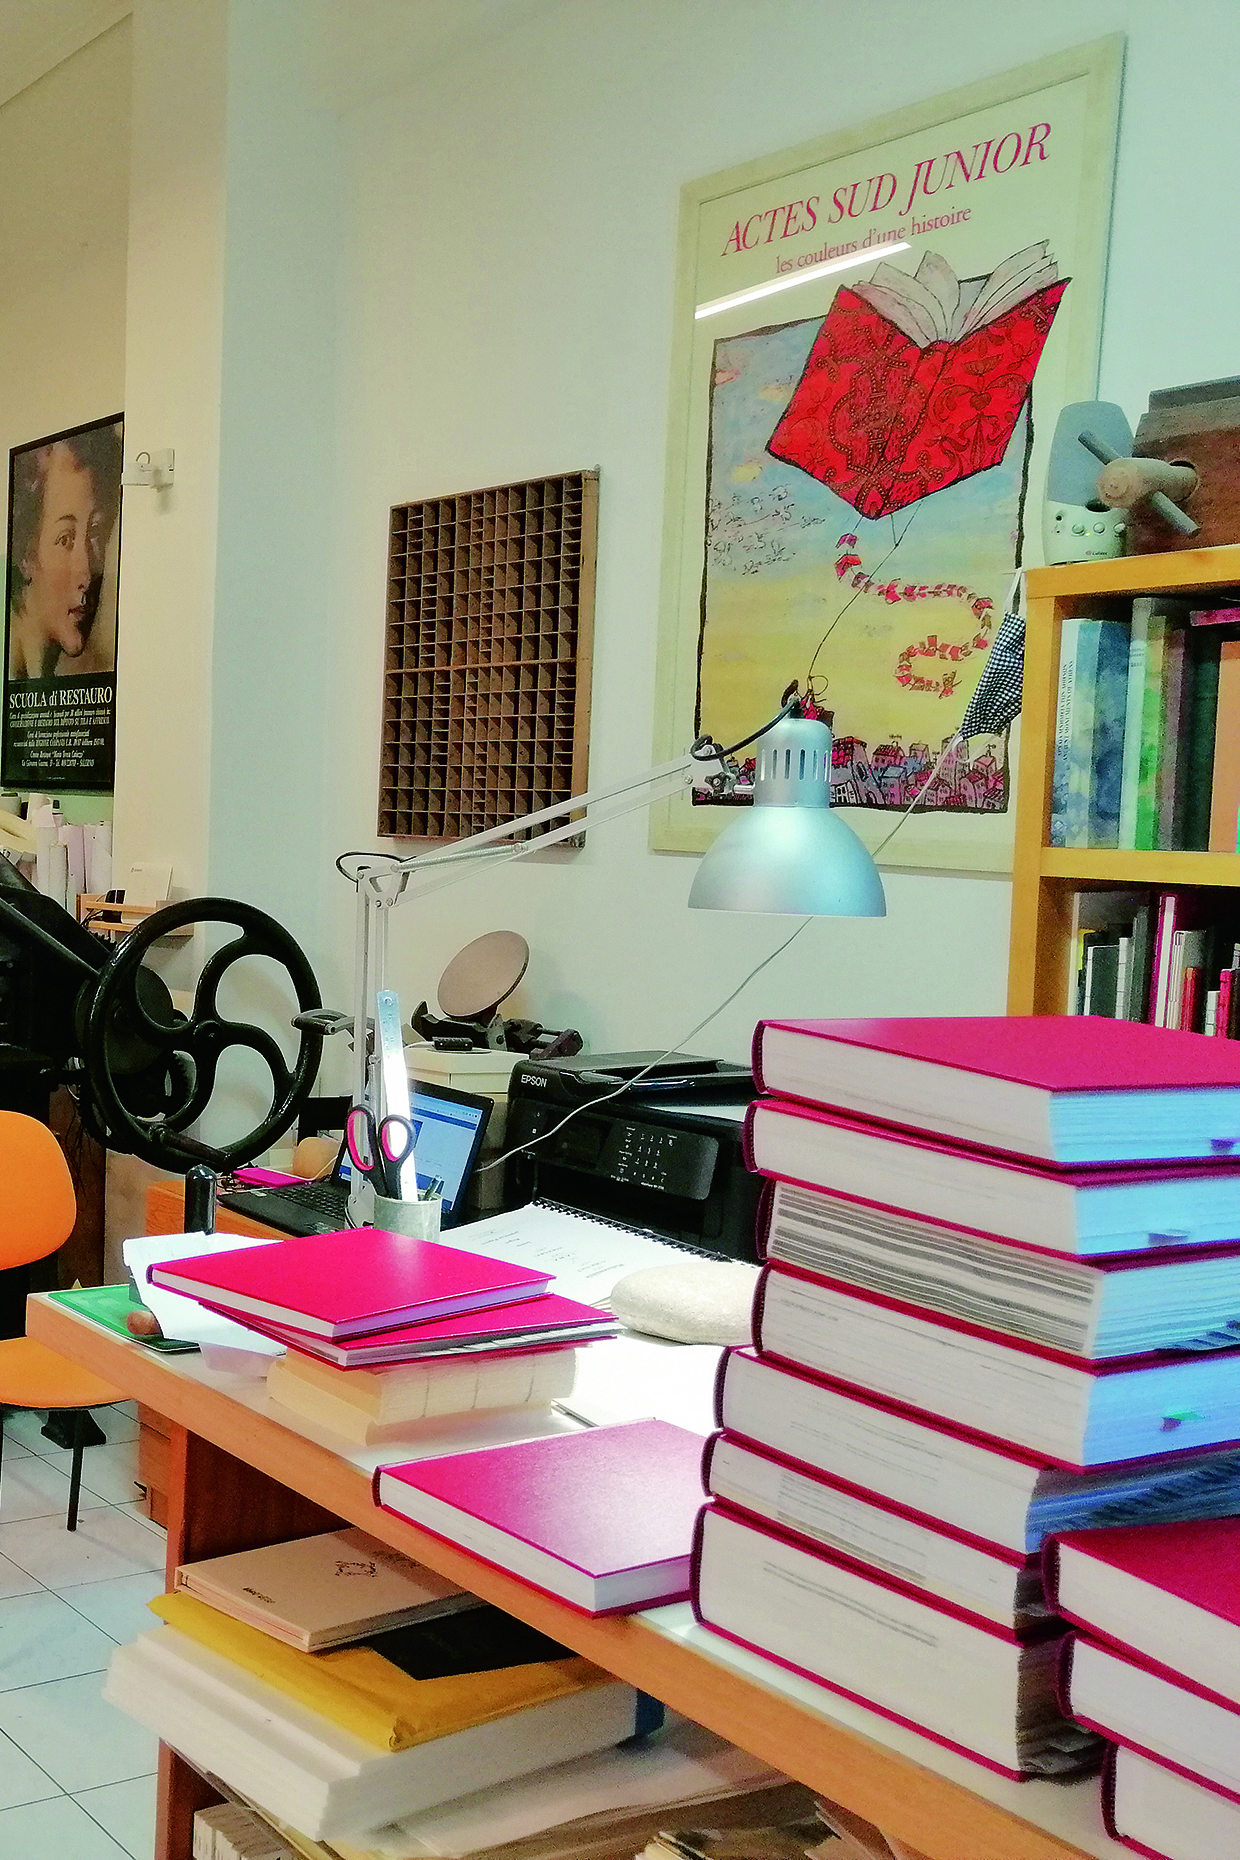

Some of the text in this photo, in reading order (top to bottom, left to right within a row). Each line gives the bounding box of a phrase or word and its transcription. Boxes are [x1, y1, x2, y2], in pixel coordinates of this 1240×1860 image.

[720, 122, 1053, 258] ACTES SUD JUNIOR
[775, 255, 794, 274] les
[796, 237, 858, 268] couleurs
[910, 205, 972, 236] histoire
[9, 686, 113, 709] SCUOLA di RESTAURO
[520, 1074, 548, 1088] EPSON
